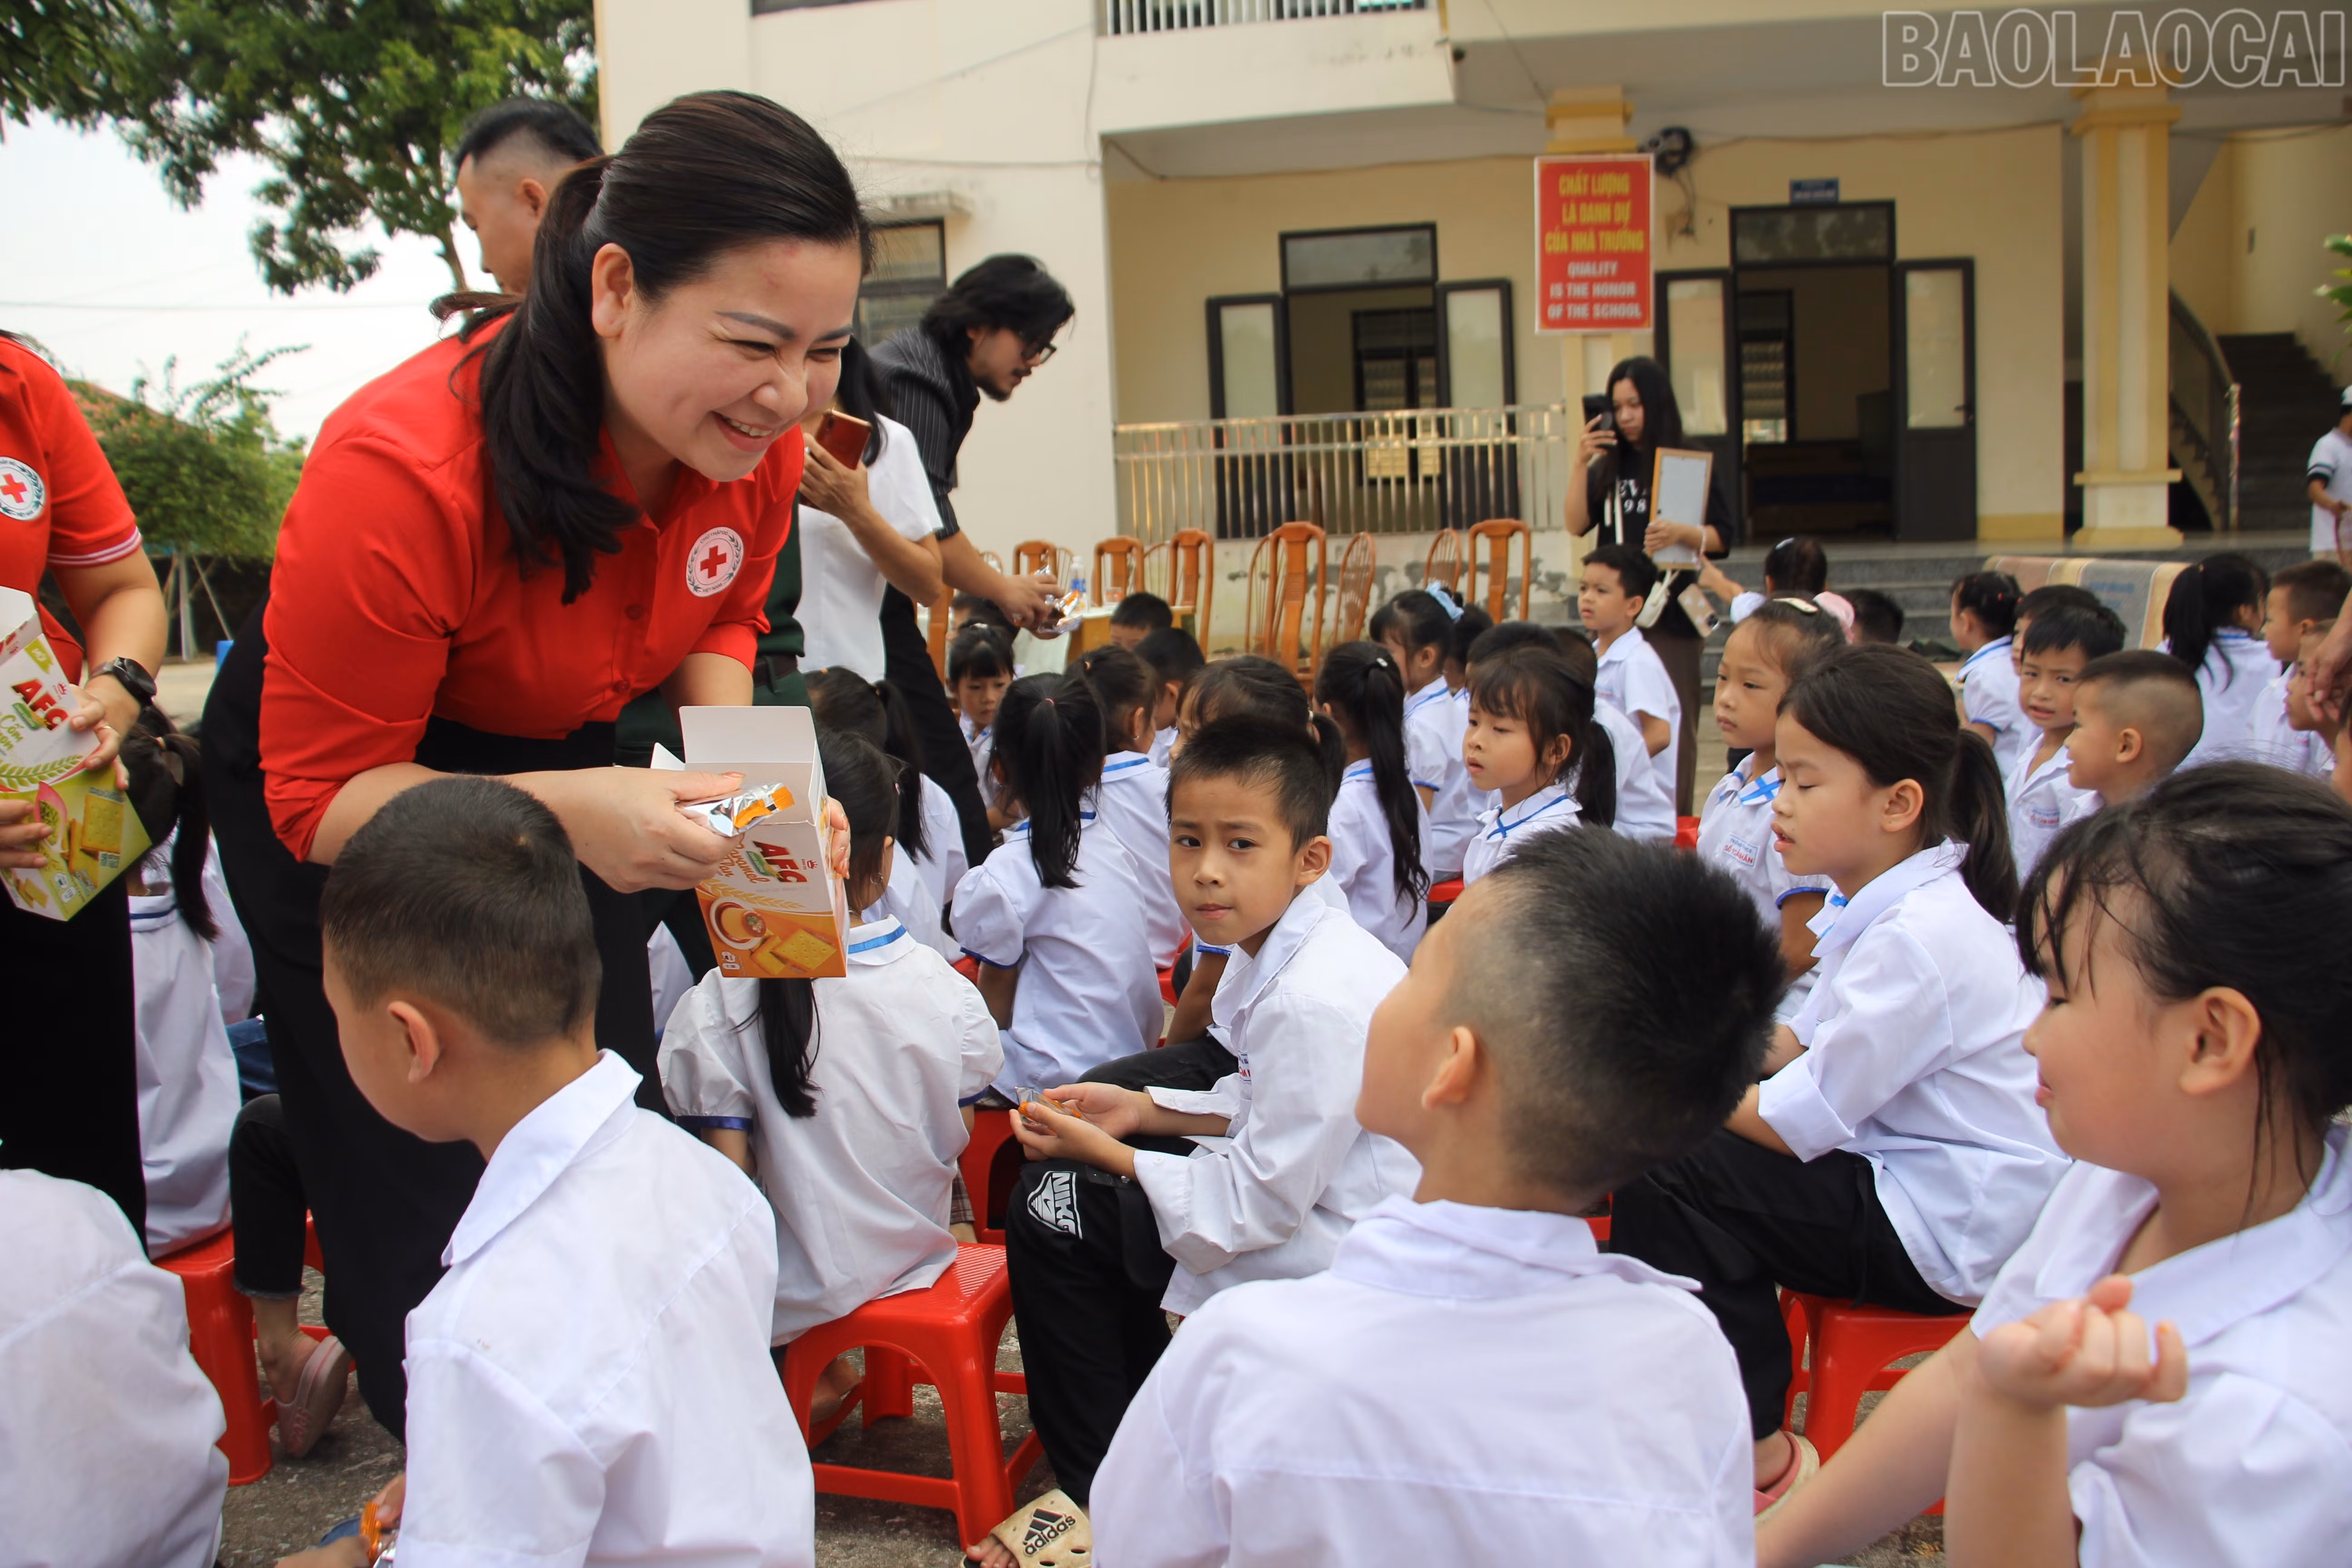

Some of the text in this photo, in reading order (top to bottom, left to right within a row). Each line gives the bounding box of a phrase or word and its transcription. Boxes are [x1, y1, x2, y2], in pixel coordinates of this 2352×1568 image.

[1580, 203, 1611, 224] DANH
[1568, 261, 1618, 279] QUALITY
[1550, 281, 1637, 299] IS THE HONOR
[1548, 304, 1563, 320] OF
[1567, 304, 1589, 320] THE
[10, 678, 69, 730] AFC
[752, 840, 808, 882] AFC
[1023, 1514, 1076, 1555] adidas
